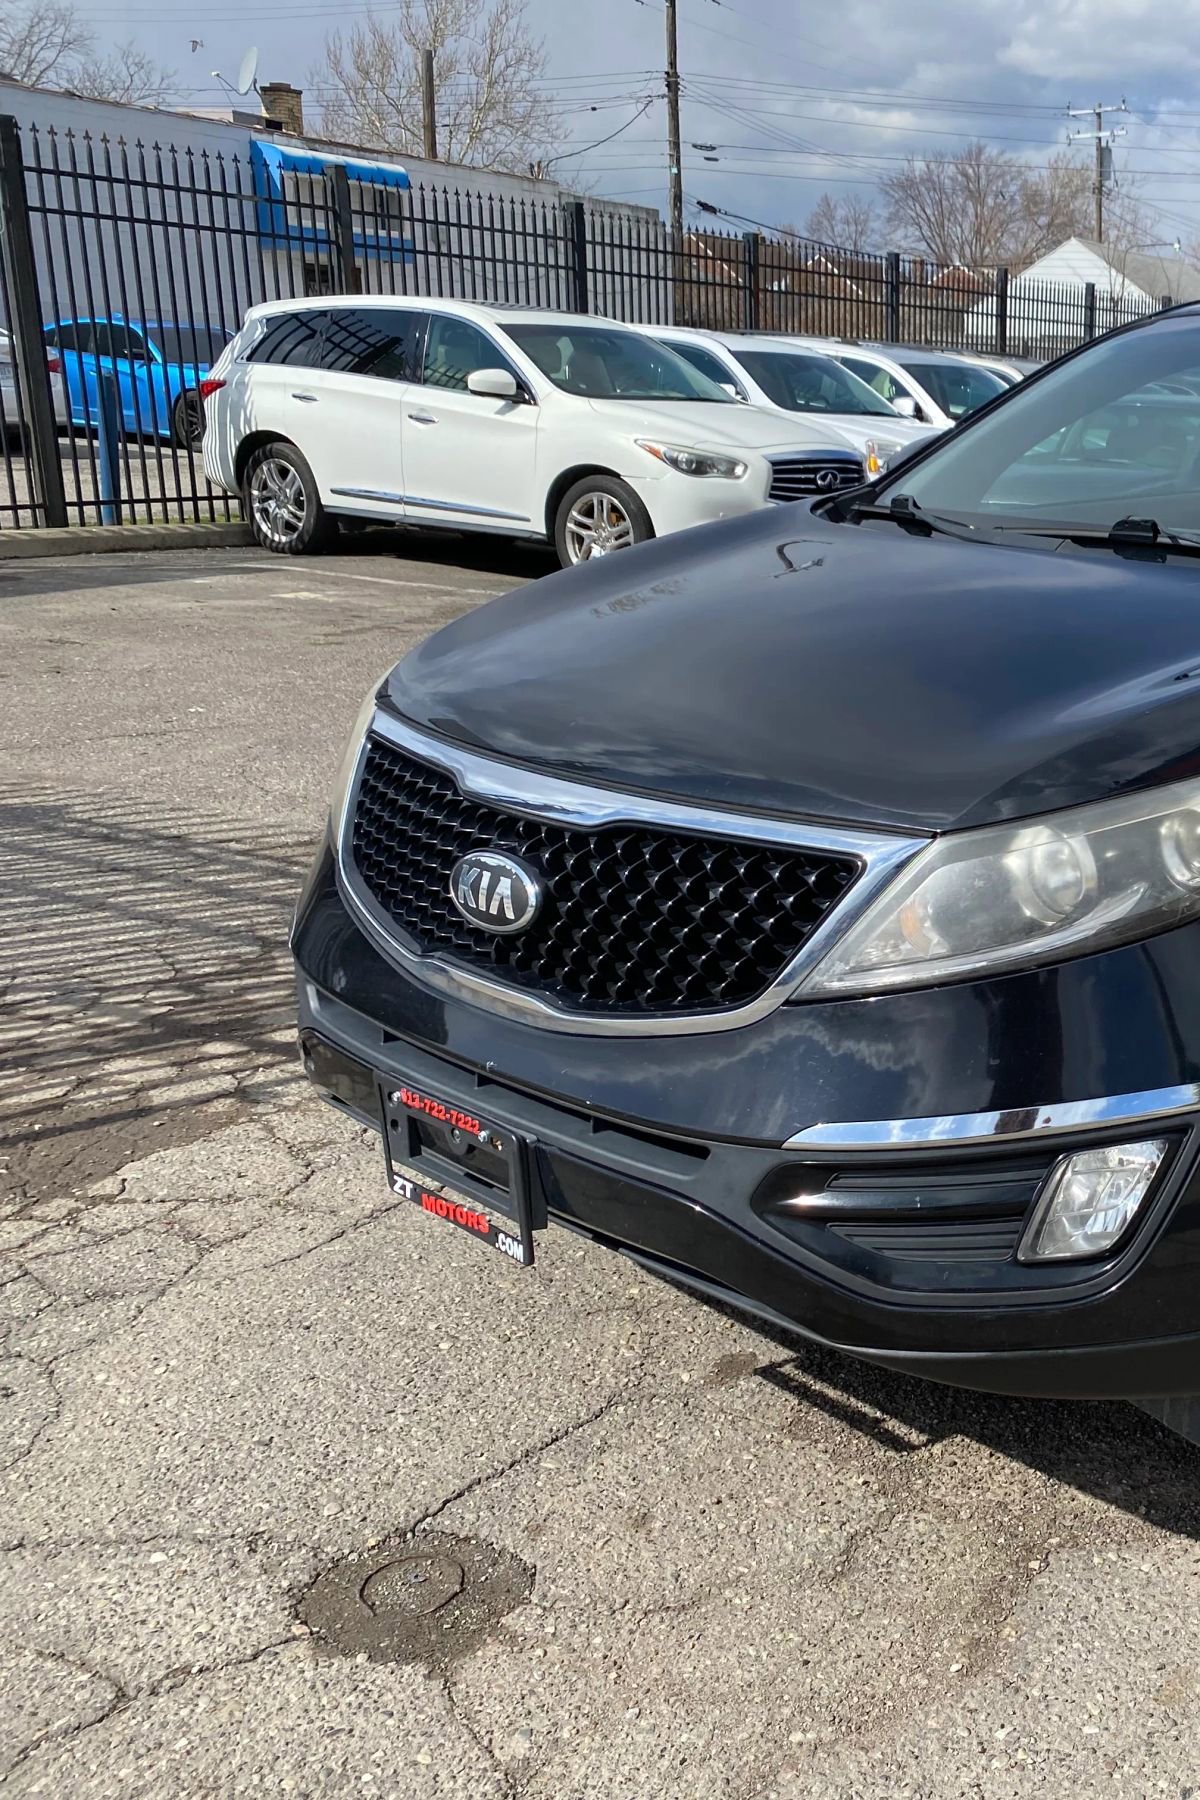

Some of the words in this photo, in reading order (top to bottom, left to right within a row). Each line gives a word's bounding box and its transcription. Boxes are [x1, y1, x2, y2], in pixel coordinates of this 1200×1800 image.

[458, 864, 515, 920] KIA
[393, 1175, 413, 1199] ZT
[421, 1193, 490, 1234] MOTORS
[495, 1232, 524, 1263] .COM
